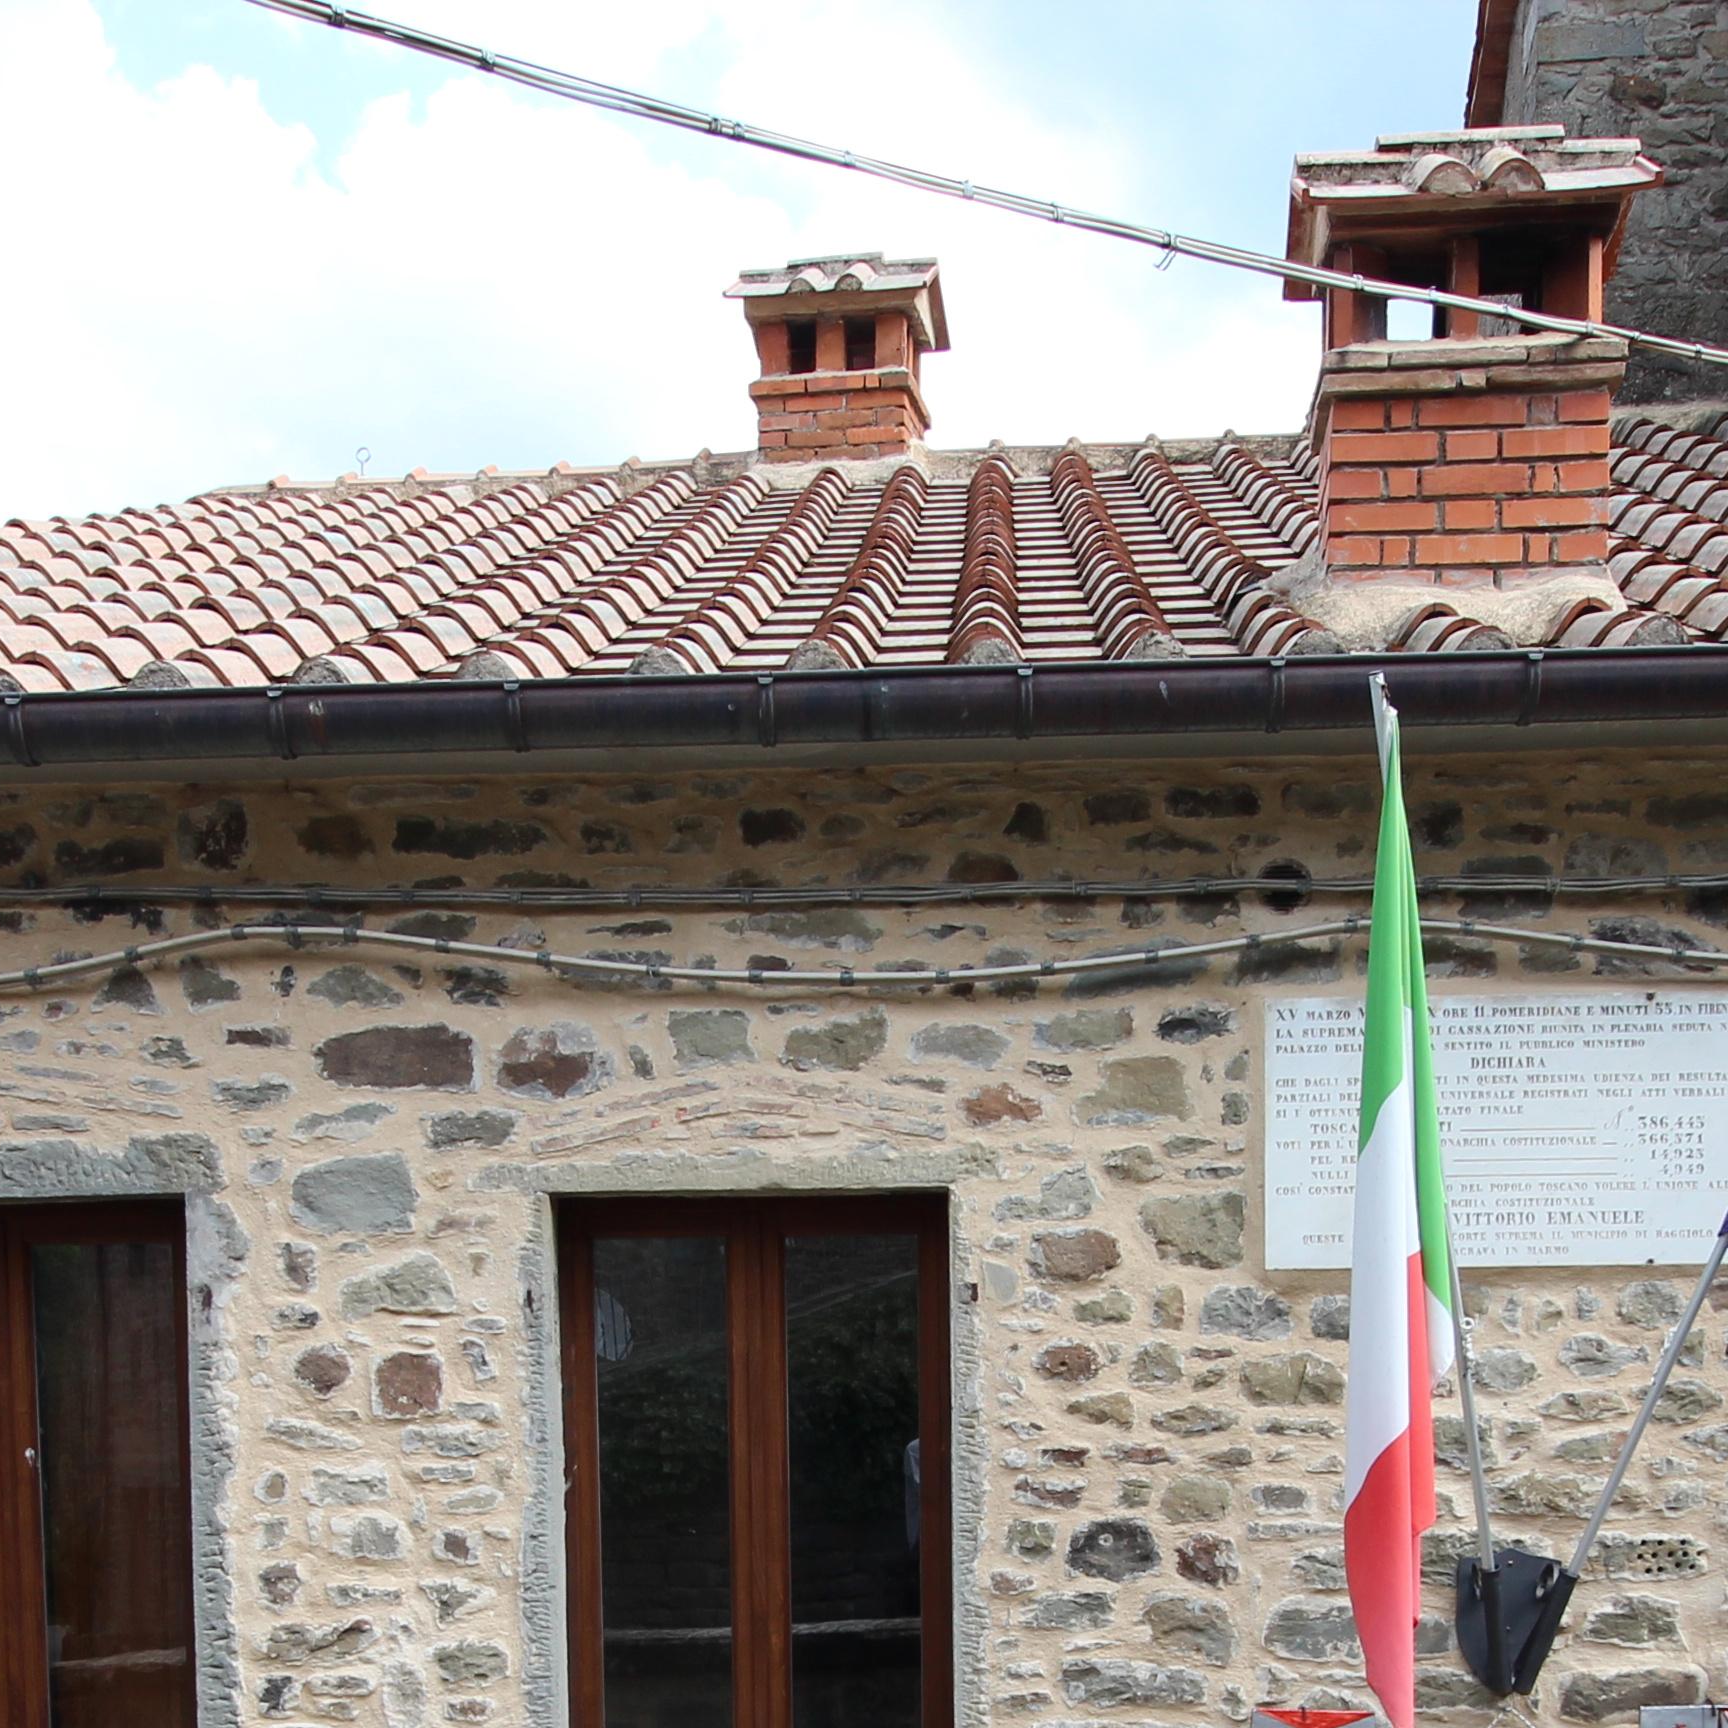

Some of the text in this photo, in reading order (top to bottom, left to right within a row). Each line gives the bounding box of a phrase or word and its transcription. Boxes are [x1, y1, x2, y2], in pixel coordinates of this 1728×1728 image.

[1276, 1008, 1299, 1021] XV
[1306, 1007, 1351, 1021] MARZO
[1443, 1007, 1469, 1019] ORE
[1492, 1006, 1581, 1018] POMERIDIANE
[1587, 1006, 1595, 1016] E
[1600, 1004, 1649, 1016] MINUTI
[1679, 1004, 1692, 1015] IN
[1276, 1027, 1294, 1039] LA
[1448, 1023, 1535, 1036] CASSAZIONE
[1541, 1023, 1586, 1034] RIUNITA
[1592, 1023, 1605, 1033] IN
[1610, 1023, 1664, 1033] PLENARIA
[1672, 1022, 1713, 1032] SEDUTA
[1276, 1044, 1328, 1055] PALAZZO
[1444, 1041, 1493, 1051] SENTITO
[1499, 1041, 1512, 1050] IL
[1519, 1040, 1575, 1049] PUBBLICO
[1582, 1038, 1646, 1049] MINISTERO
[1471, 1056, 1546, 1070] DICHIARA
[1275, 1078, 1298, 1089] CHE
[1456, 1075, 1470, 1085] IN
[1476, 1074, 1518, 1085] QUESTA
[1527, 1073, 1586, 1084] MEDESIMA
[1593, 1073, 1644, 1083] UDIENZA
[1651, 1072, 1671, 1083] DEI
[1276, 1094, 1331, 1104] PARZIALI
[1440, 1090, 1515, 1101] UNIVERSALE
[1522, 1089, 1589, 1100] REGISTRATI
[1597, 1088, 1632, 1099] NEGLI
[1640, 1088, 1667, 1098] ATTI
[1673, 1087, 1726, 1098] VERBALI
[1276, 1109, 1287, 1119] SI
[1479, 1105, 1524, 1115] FINALE
[1276, 1141, 1301, 1151] VOTI
[1310, 1140, 1332, 1150] PER
[1502, 1136, 1597, 1147] COSTITUZIONALE
[1310, 1155, 1333, 1165] PEL
[1311, 1170, 1349, 1180] NULLI
[1460, 1182, 1483, 1193] DEL
[1489, 1182, 1532, 1192] POPOLO
[1538, 1182, 1588, 1192] TOSCANO
[1594, 1181, 1637, 1192] VOLERE
[1495, 1197, 1595, 1208] COSTITUZIONALE
[1452, 1210, 1646, 1227] VITTORIO EMANUELE
[1303, 1234, 1345, 1245] QUESTE
[1495, 1230, 1544, 1242] SUPREMA
[1551, 1230, 1564, 1241] IL
[1571, 1229, 1628, 1240] MUNICIPIO
[1635, 1229, 1648, 1239] DI
[1655, 1229, 1714, 1239] RAGGIOLO
[1505, 1246, 1519, 1257] IN
[1527, 1245, 1570, 1256] MARMO
